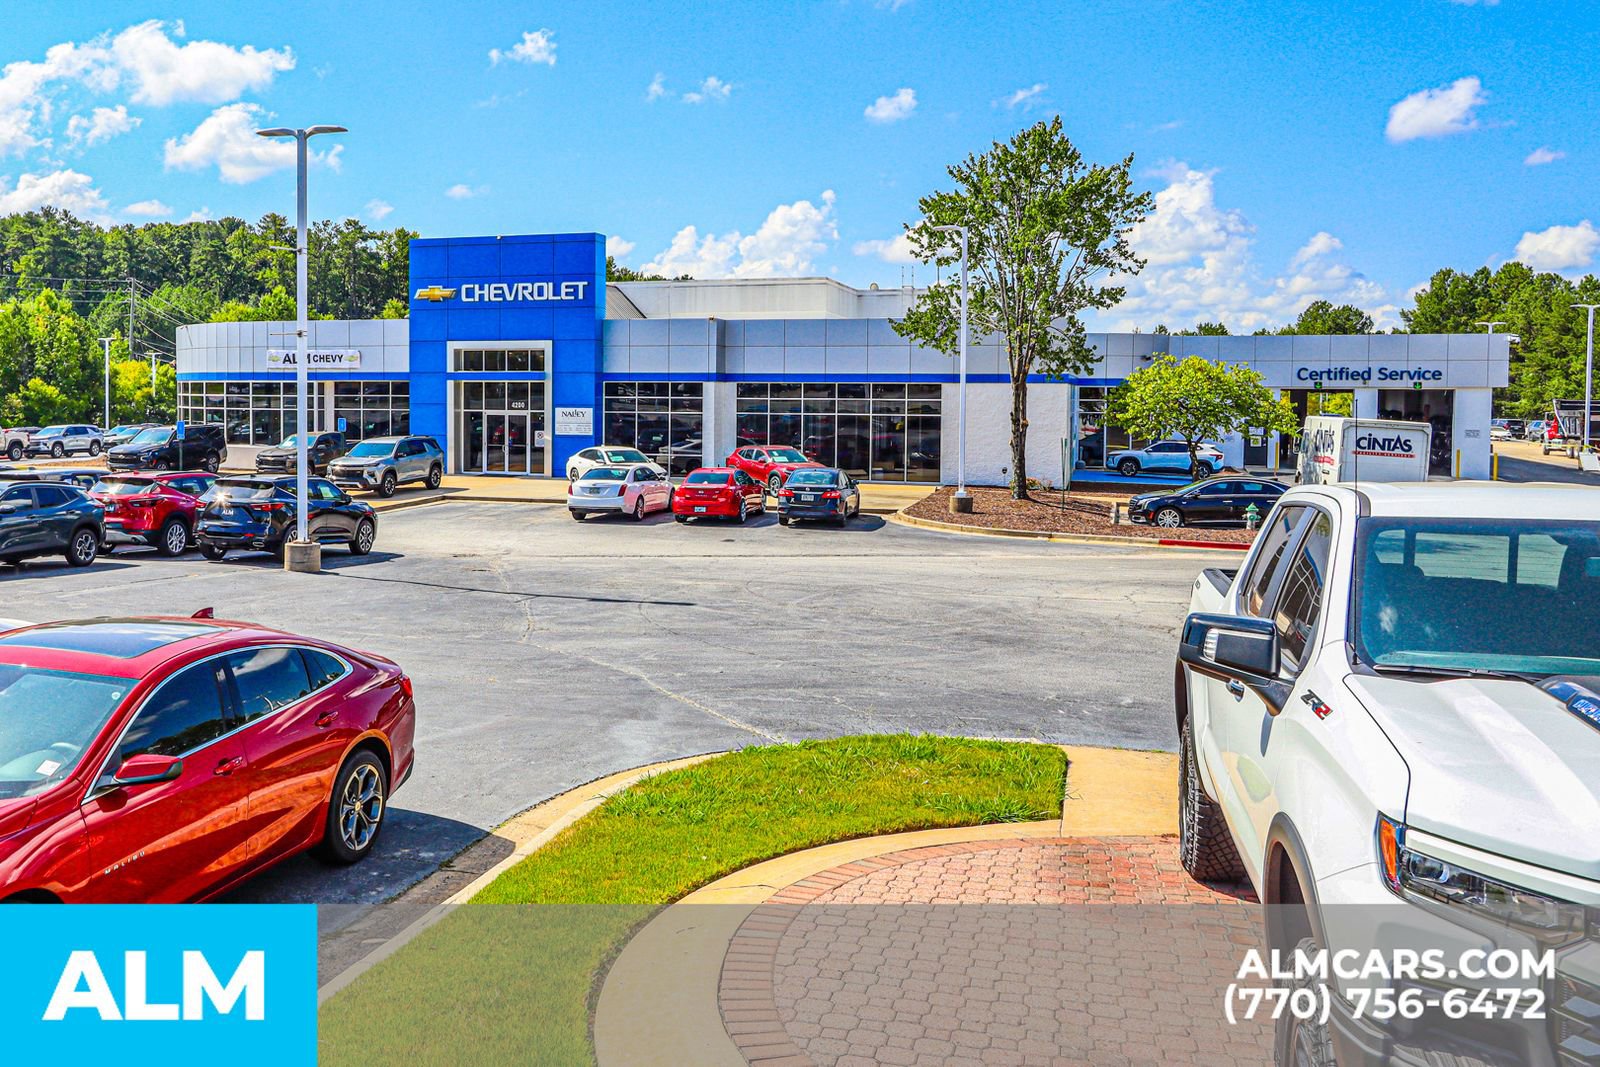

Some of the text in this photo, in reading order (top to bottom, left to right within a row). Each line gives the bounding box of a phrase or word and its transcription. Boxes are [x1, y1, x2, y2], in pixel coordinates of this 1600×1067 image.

[461, 281, 588, 302] CHEVROLET
[312, 354, 343, 363] CHEVY
[1297, 367, 1442, 381] Certified Service
